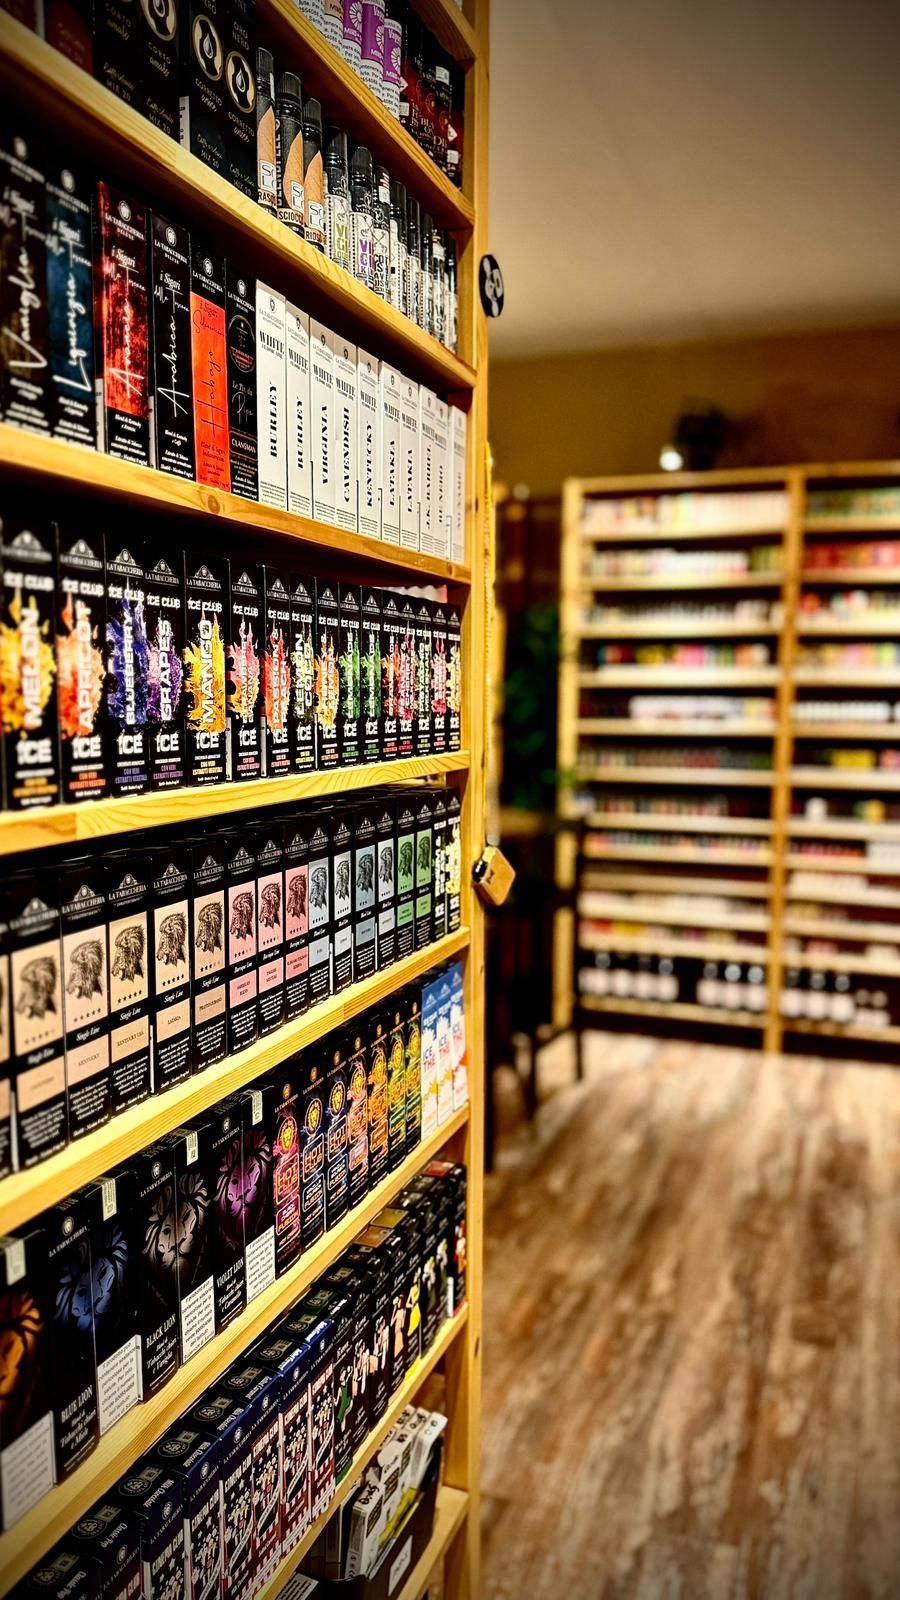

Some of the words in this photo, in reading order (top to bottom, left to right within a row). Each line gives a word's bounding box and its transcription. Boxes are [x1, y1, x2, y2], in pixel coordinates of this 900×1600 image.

[260, 330, 285, 355] WHITE
[157, 315, 190, 418] Arabica
[289, 348, 309, 371] WHITE
[313, 364, 334, 386] WHITE
[336, 377, 356, 398] WHITE
[361, 390, 377, 409] WHITE
[384, 401, 400, 421] WHITE
[402, 411, 418, 430] WHITE
[231, 438, 257, 454] CLANSMAN
[321, 405, 329, 485] VIRGINIA
[106, 561, 114, 571] LA
[114, 563, 144, 577] TABACCHERIA
[145, 571, 152, 581] LA
[152, 573, 179, 585] TABACCHERIA
[62, 576, 79, 594] ICE
[80, 581, 104, 598] CLUB
[108, 584, 123, 599] ICE
[124, 589, 145, 603] CLUB
[186, 578, 192, 586] LA
[193, 579, 222, 590] TABACCHERIA
[146, 592, 160, 607] ICE
[161, 596, 180, 609] CLUB
[187, 597, 201, 611] ICE
[202, 600, 222, 613] CLUB
[232, 602, 243, 614] ICE
[244, 606, 259, 618] CLUB
[267, 608, 276, 620] ICE
[277, 610, 290, 621] CLUB
[292, 611, 300, 622] ICE
[301, 614, 312, 623] CLUB
[318, 615, 327, 626] ICE
[327, 617, 339, 627] CLUB
[341, 618, 349, 628] ICE
[349, 620, 360, 630] CLUB
[362, 619, 371, 630] ICE
[371, 621, 381, 632] CLUB
[158, 619, 174, 723] GRAPES
[199, 620, 214, 724] MANGO
[295, 634, 304, 717] LEMON
[272, 727, 288, 744] ICE
[296, 721, 312, 741] ICE
[344, 717, 357, 738] ICE
[366, 716, 379, 735] ICE
[116, 728, 144, 756] ICE
[154, 728, 180, 753] ICE
[194, 730, 220, 750] ICE
[238, 725, 258, 747] ICE
[72, 734, 102, 760] ICE
[153, 880, 160, 889] LA
[160, 873, 188, 887] TABACCHERIA
[109, 891, 117, 901] LA
[117, 884, 147, 898] TABACCHERIA
[62, 903, 70, 914] LA
[70, 896, 105, 911] TABACCHERIA
[164, 993, 174, 1004] Single
[174, 989, 184, 999] Line
[120, 1010, 131, 1022] Single
[131, 1006, 142, 1018] Line
[330, 1124, 346, 1143] HOT
[304, 1142, 323, 1164] HOT
[329, 1134, 346, 1154] CLUB
[278, 1163, 298, 1185] HOT
[304, 1153, 323, 1175] CLUB
[278, 1173, 298, 1197] CLUB
[217, 1268, 234, 1288] VIOLET
[233, 1256, 244, 1275] LION
[146, 1324, 164, 1349] BLACK
[163, 1313, 176, 1335] LION
[61, 1400, 78, 1424] BLUE
[77, 1385, 93, 1408] LION
[225, 1466, 242, 1492] CINEMA
[242, 1453, 252, 1474] CLUB
